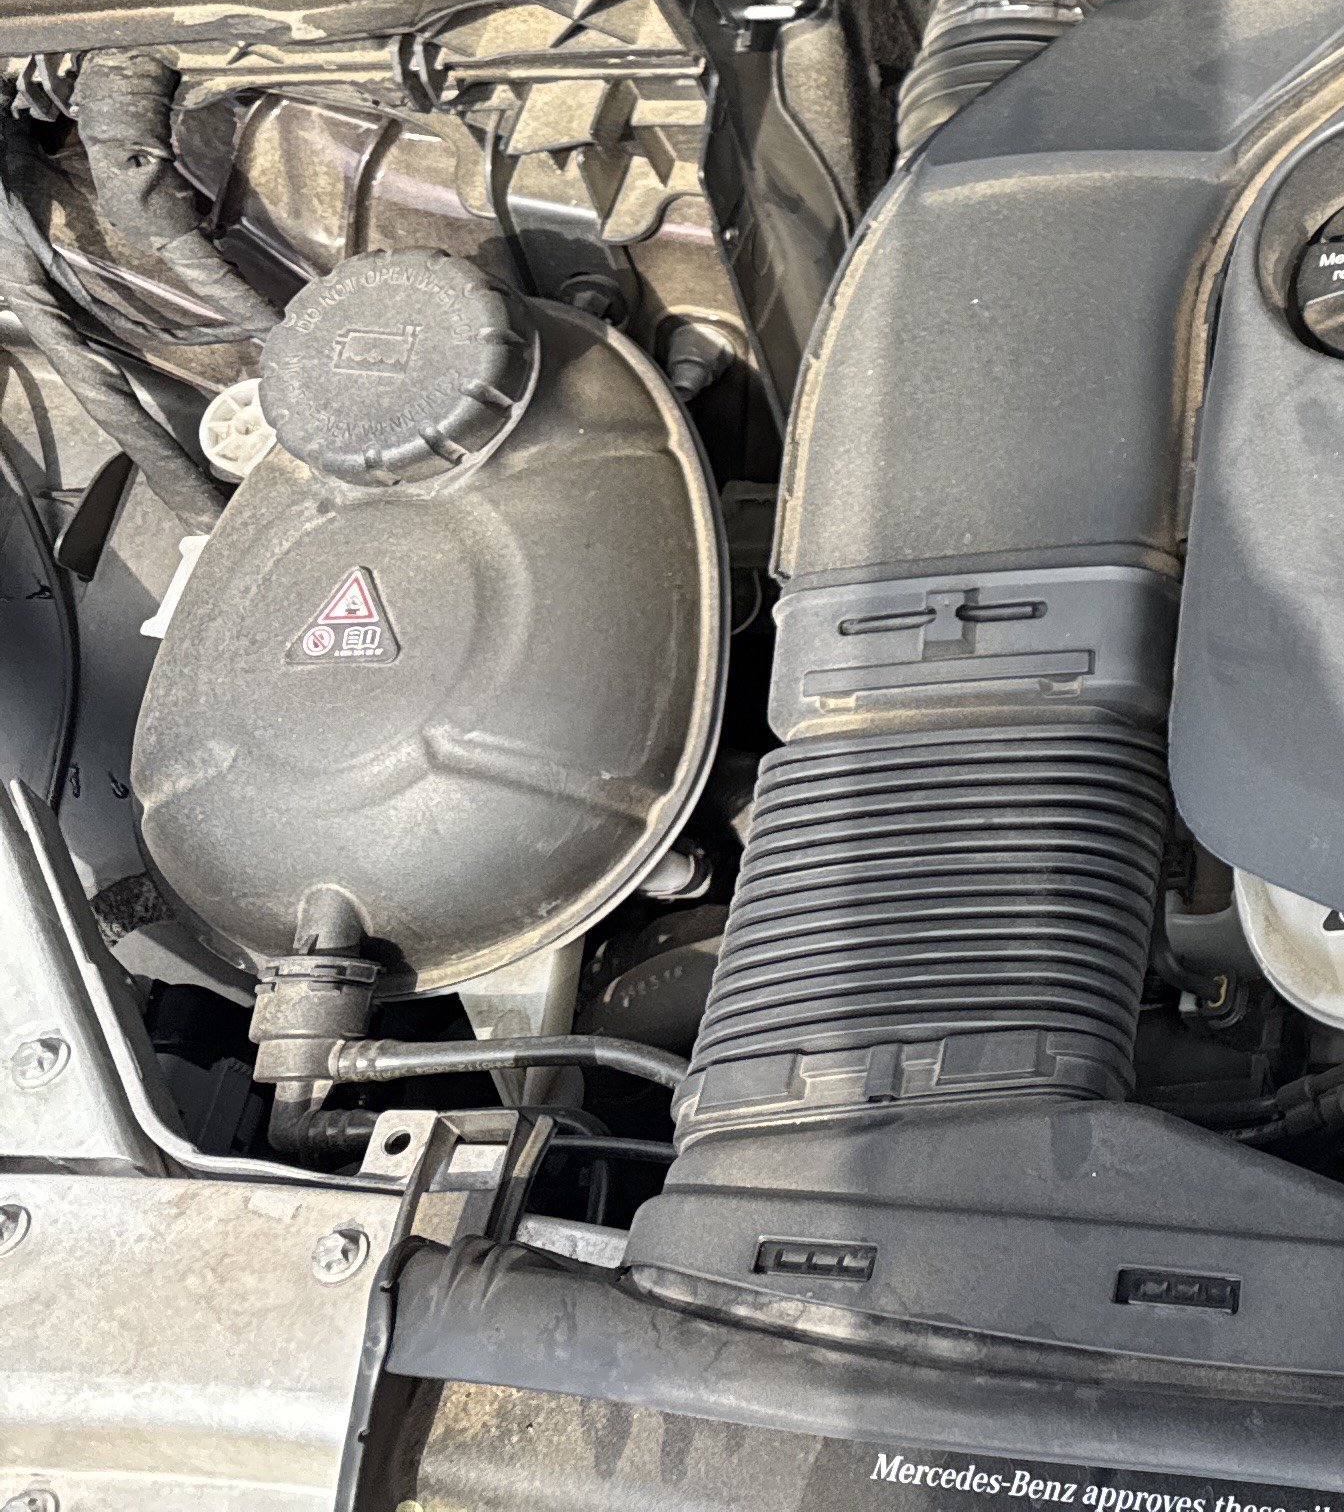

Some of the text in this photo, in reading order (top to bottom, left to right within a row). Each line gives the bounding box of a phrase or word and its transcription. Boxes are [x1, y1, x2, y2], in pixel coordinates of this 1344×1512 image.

[296, 308, 321, 333] DO
[362, 268, 415, 287] OPEN
[870, 1453, 1077, 1503] Mercedes-Benz
[1082, 1485, 1206, 1512] approves
